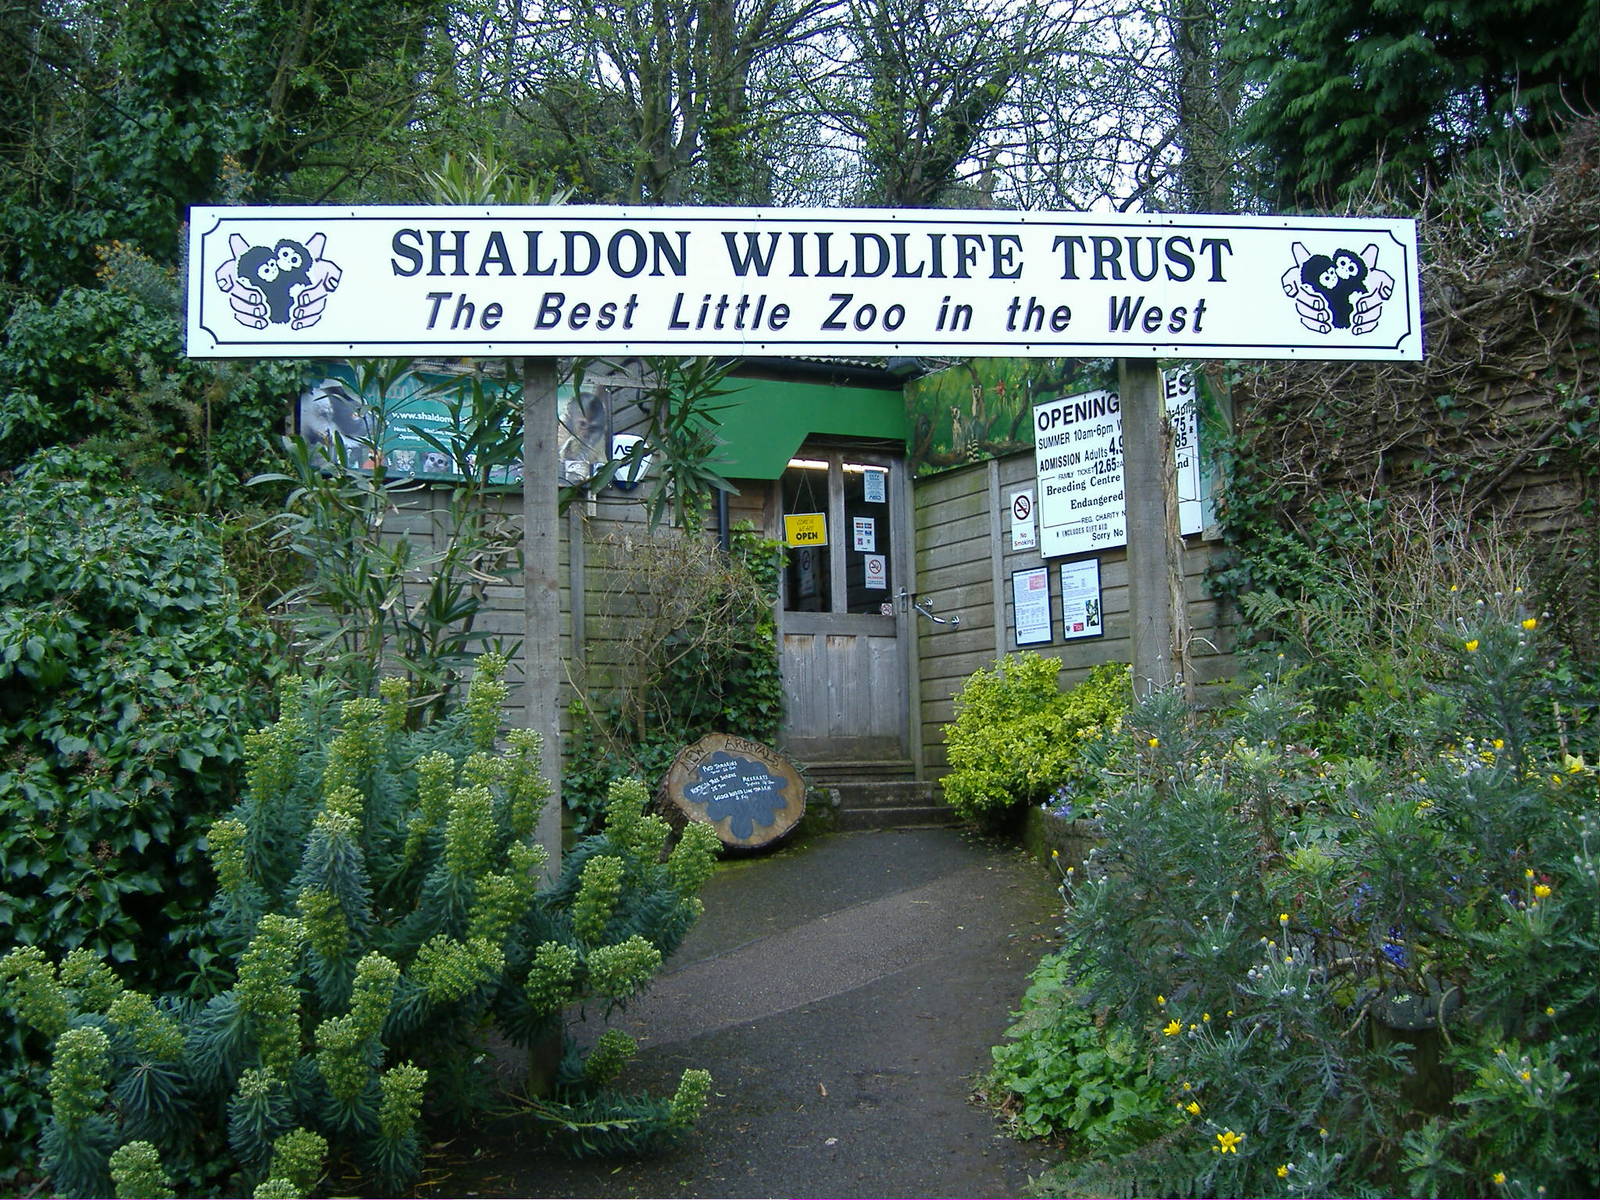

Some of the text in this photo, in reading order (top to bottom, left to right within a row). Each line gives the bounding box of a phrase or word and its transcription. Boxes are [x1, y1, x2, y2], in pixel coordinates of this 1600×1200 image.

[391, 228, 1233, 282] SHALDON WILDLIFE TRUST
[426, 292, 1207, 333] The Best Little Zoo in the West
[1038, 393, 1120, 431] OPENING
[1038, 432, 1071, 450] SUMMER
[1040, 452, 1081, 472] ADMISSION
[1084, 447, 1108, 461] Adults
[1094, 457, 1117, 475] 12.65
[1046, 480, 1087, 496] Breeding
[1090, 474, 1121, 487] Centre
[1070, 490, 1124, 510] Endangered
[1095, 511, 1119, 522] CHARITY
[796, 532, 818, 540] OPEN
[1092, 528, 1124, 541] Sorry No
[725, 737, 781, 769] ARRIVALS
